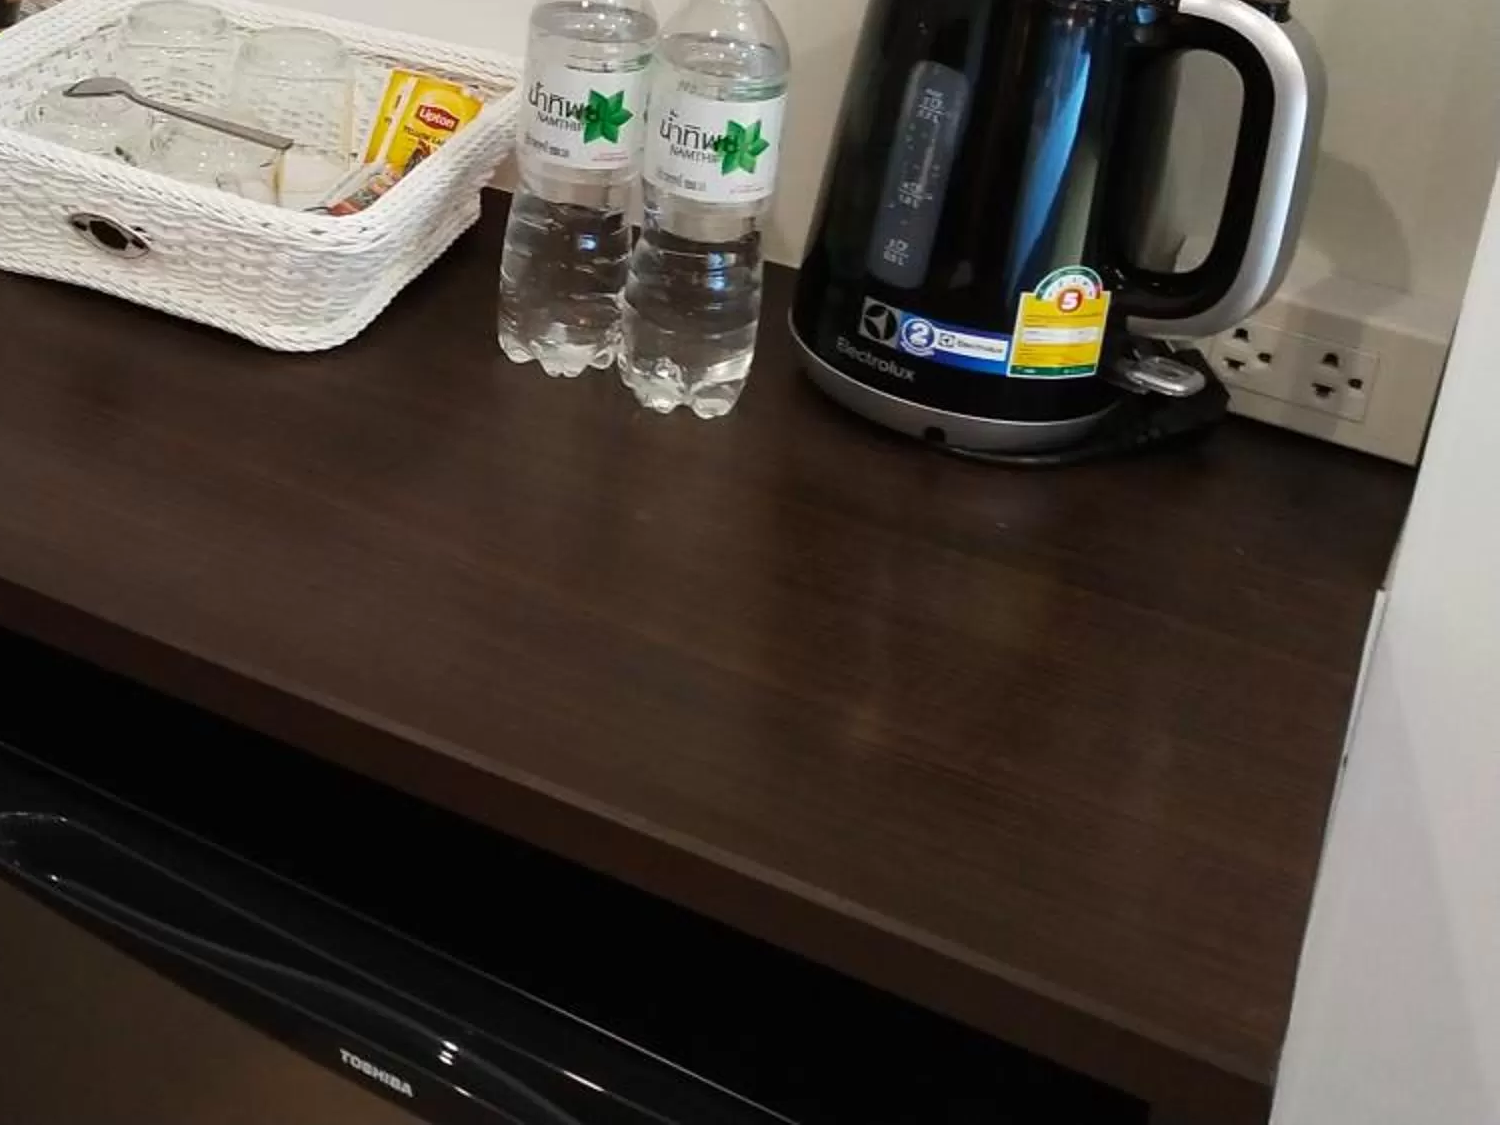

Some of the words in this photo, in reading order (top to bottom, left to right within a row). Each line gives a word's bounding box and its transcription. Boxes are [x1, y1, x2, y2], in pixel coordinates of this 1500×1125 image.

[419, 107, 456, 129] Lipton
[1061, 291, 1080, 310] 5
[909, 322, 929, 345] 2
[836, 335, 917, 383] Electrolux
[339, 1047, 414, 1098] TOSHIBA
